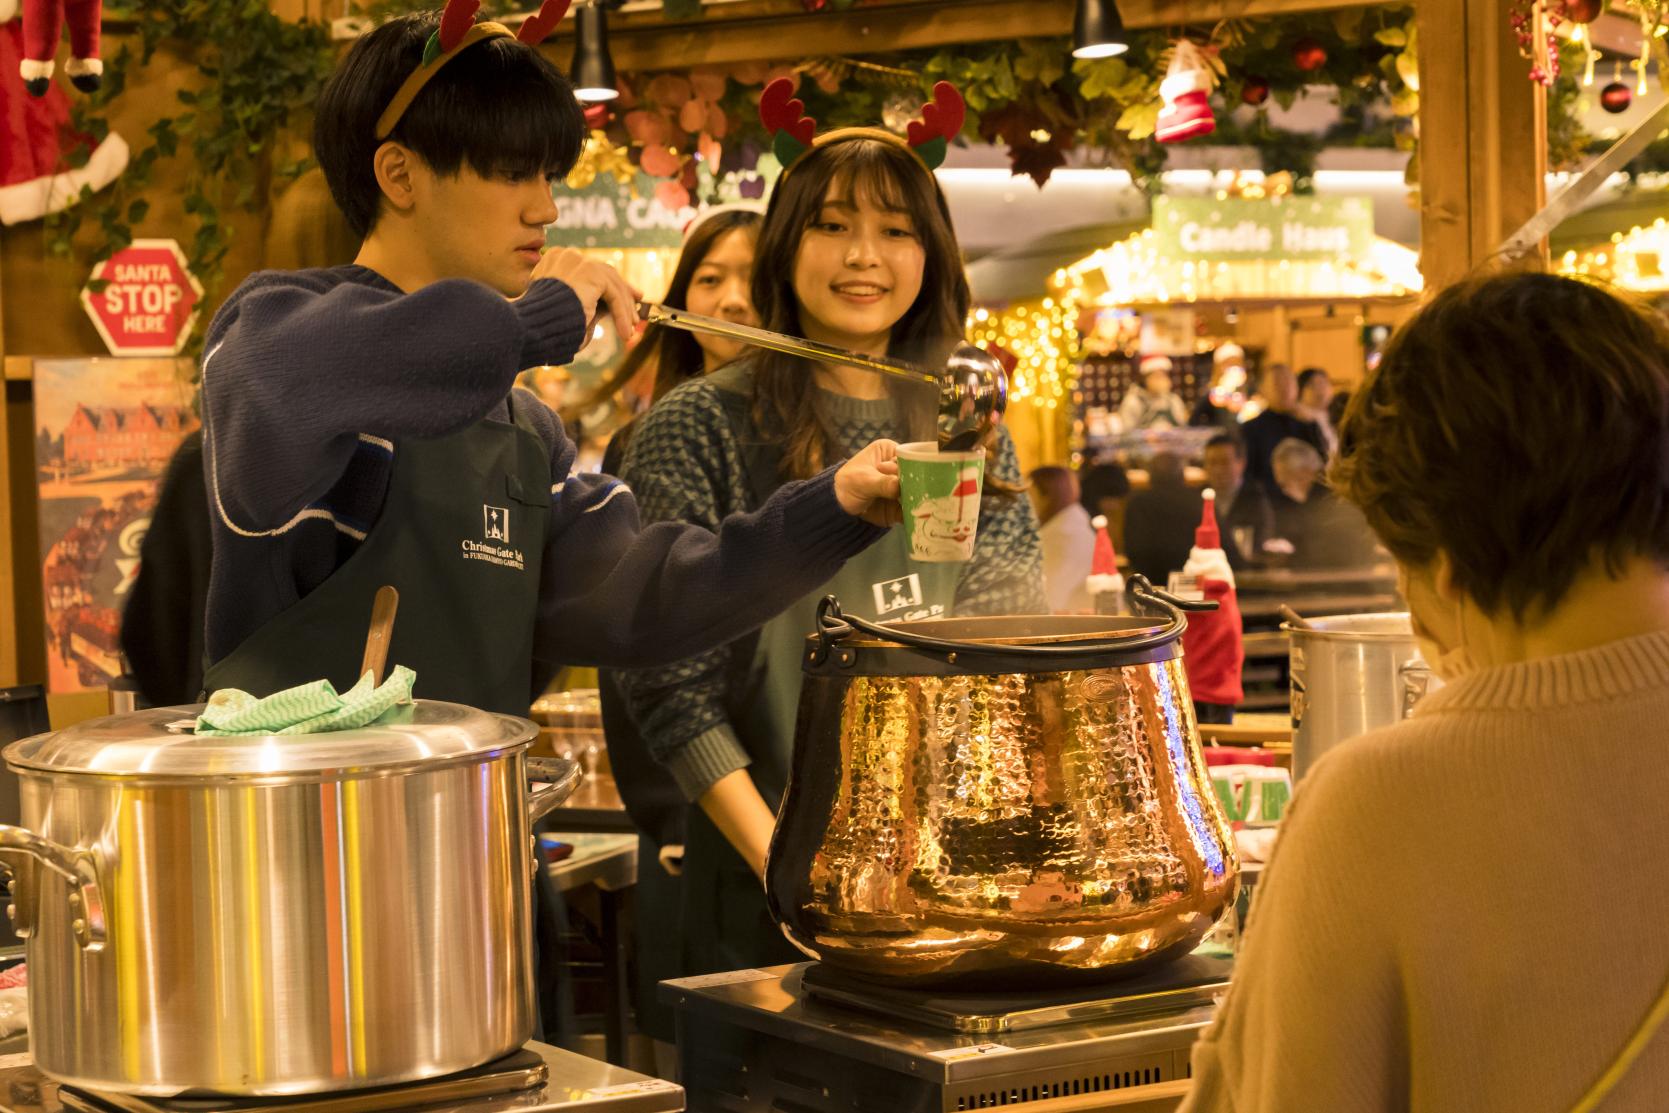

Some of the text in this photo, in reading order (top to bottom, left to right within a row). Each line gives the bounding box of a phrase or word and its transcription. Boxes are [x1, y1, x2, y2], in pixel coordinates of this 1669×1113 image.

[1180, 221, 1271, 252] Candle
[114, 264, 172, 282] SANTA
[105, 283, 182, 314] STOP
[123, 314, 166, 334] HERE
[496, 546, 514, 559] Gate
